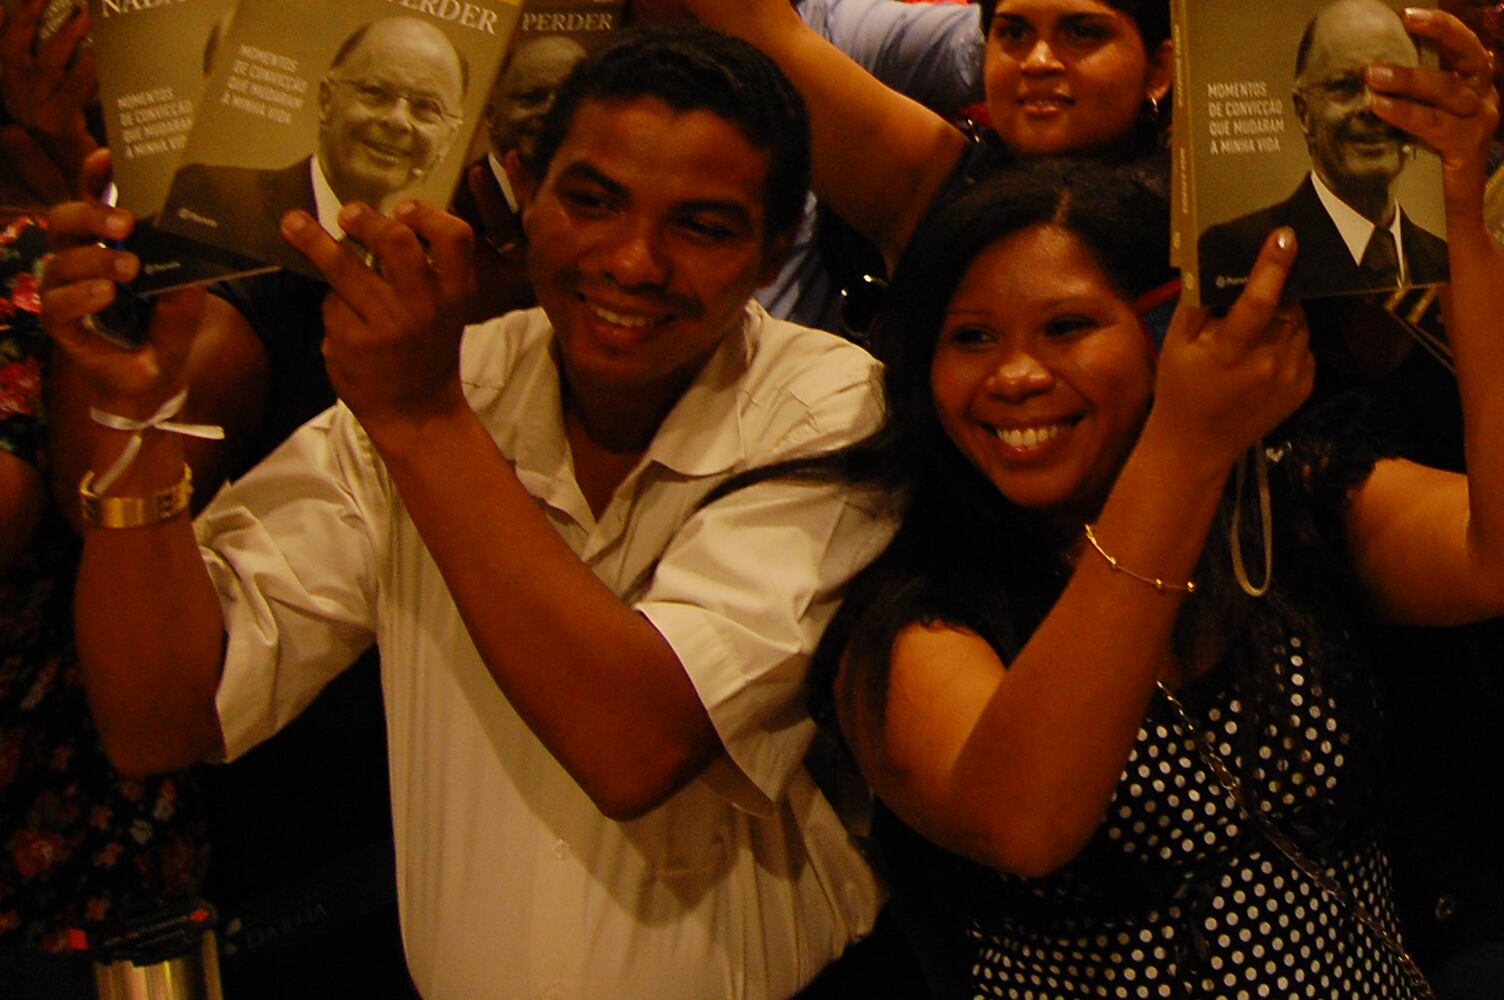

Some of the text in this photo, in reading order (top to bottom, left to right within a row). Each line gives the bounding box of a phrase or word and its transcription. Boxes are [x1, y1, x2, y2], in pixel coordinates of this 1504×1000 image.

[521, 12, 613, 32] PERDER
[1207, 81, 1267, 99] MOMENTOS
[1207, 101, 1222, 118] DE
[1209, 118, 1285, 137] QUE MUDARAM
[1209, 138, 1282, 156] A MINHA VIDA
